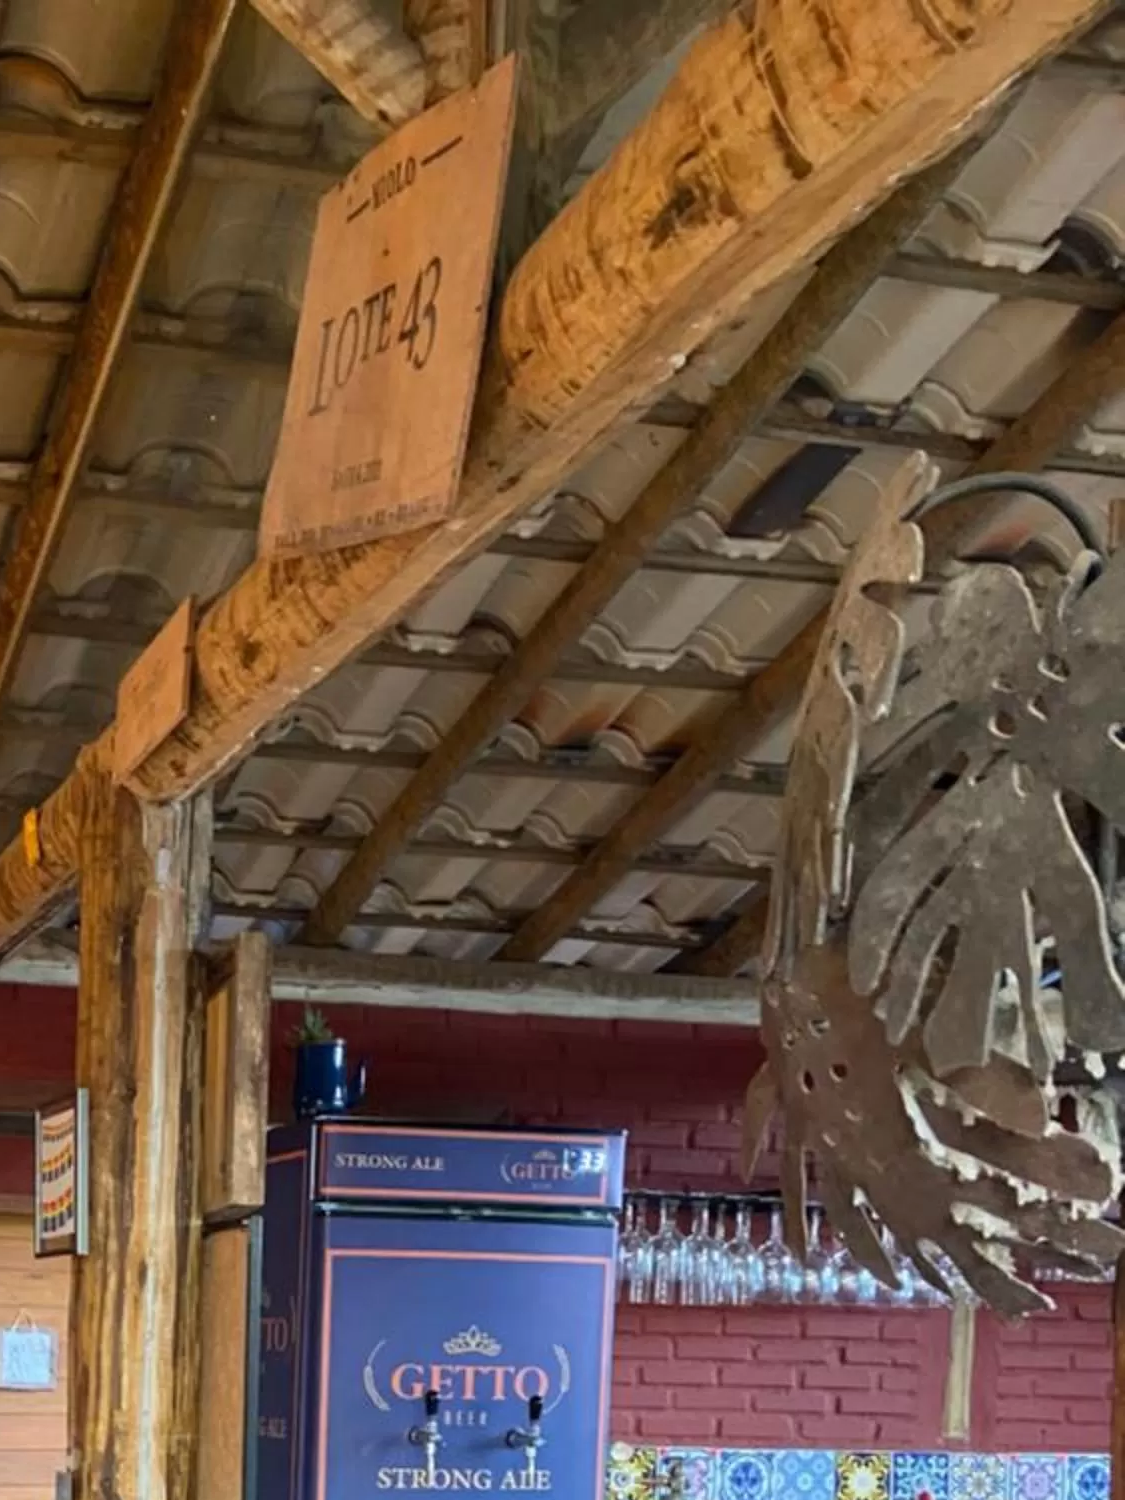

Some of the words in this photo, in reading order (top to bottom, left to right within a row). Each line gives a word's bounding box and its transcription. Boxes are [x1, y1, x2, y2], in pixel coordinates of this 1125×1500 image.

[398, 256, 442, 370] 43
[334, 1152, 407, 1170] STRONG
[411, 1156, 444, 1171] ALE
[511, 1161, 575, 1181] GETTO
[390, 1361, 550, 1403] GETTO
[376, 1467, 492, 1490] STRONG
[498, 1469, 552, 1490] ALE
